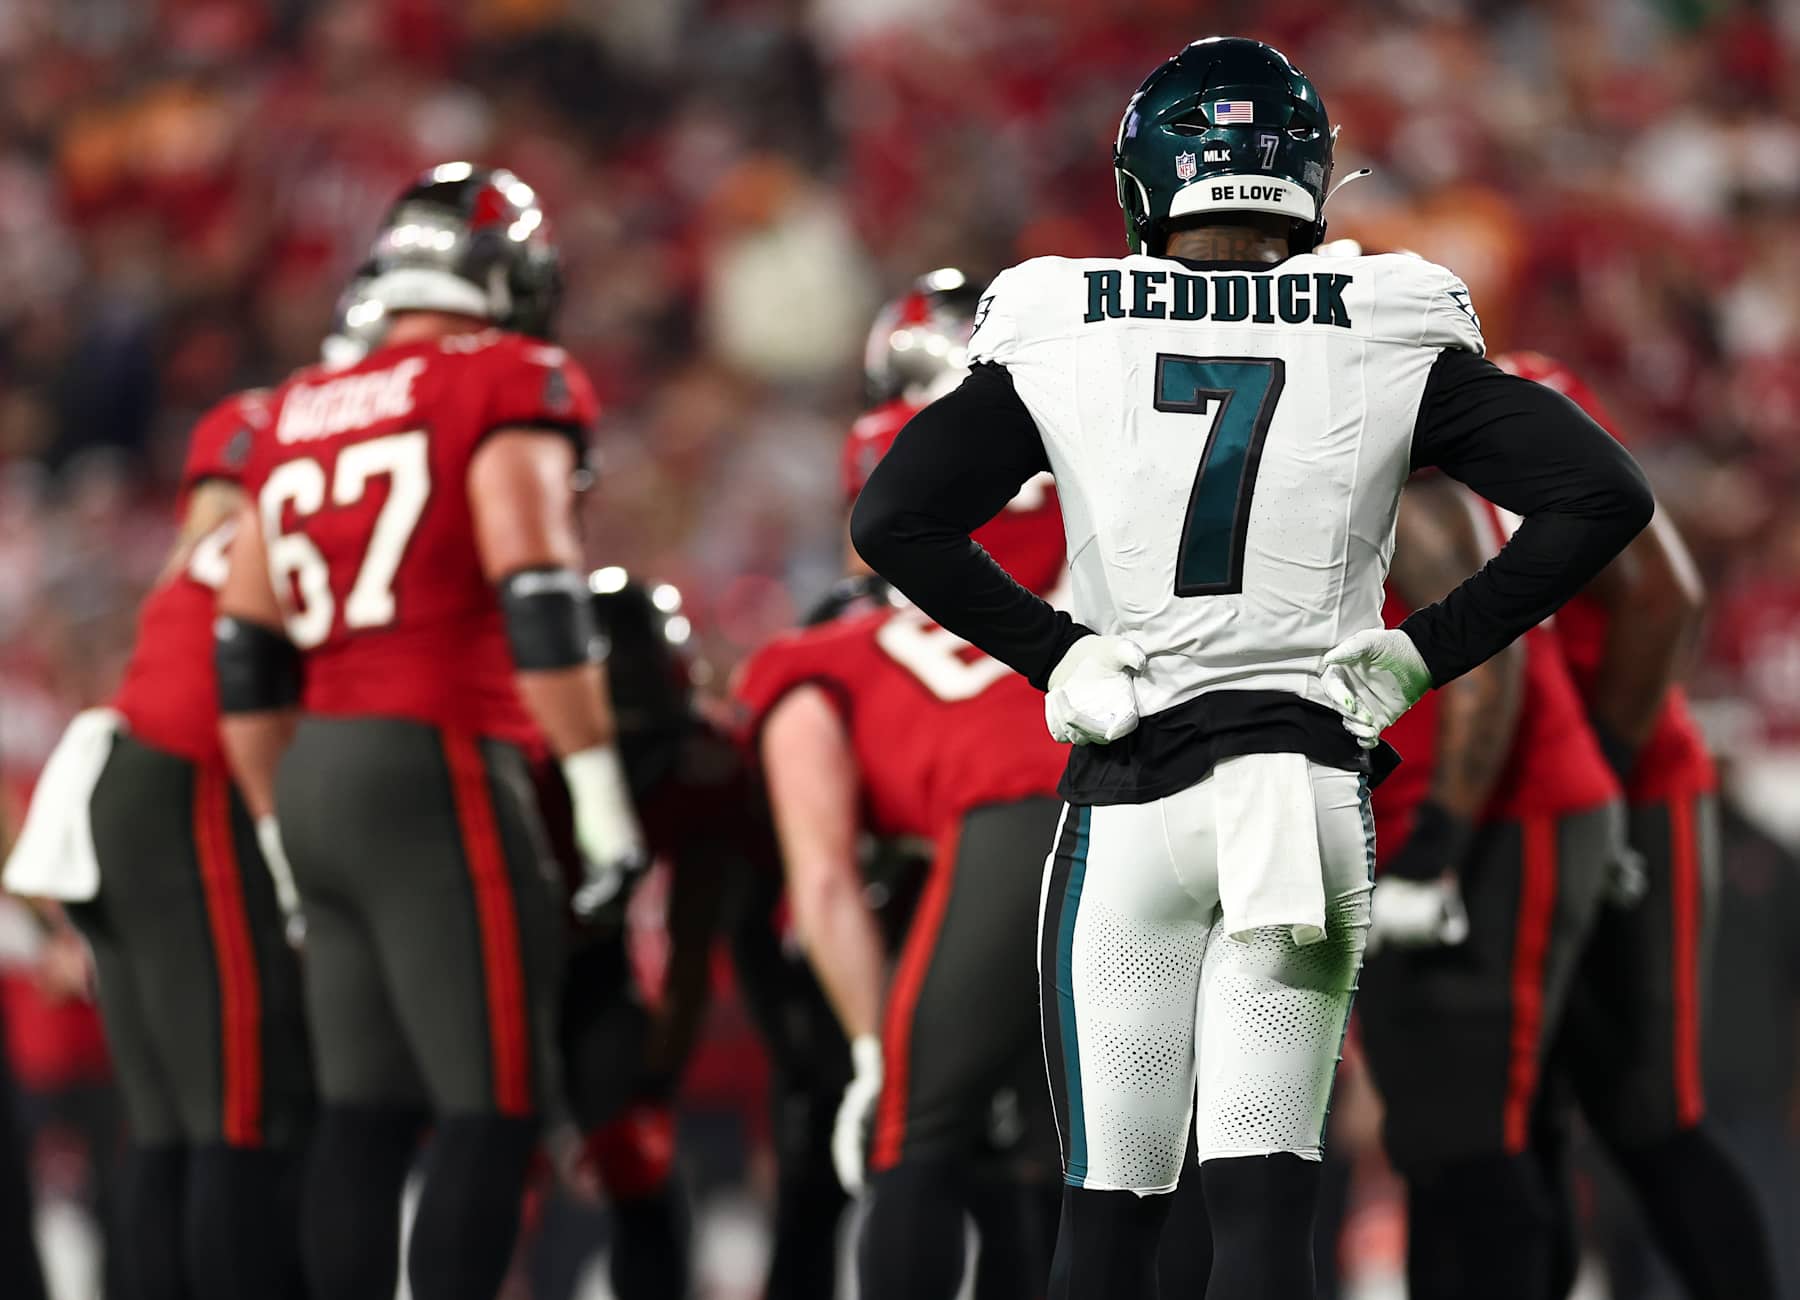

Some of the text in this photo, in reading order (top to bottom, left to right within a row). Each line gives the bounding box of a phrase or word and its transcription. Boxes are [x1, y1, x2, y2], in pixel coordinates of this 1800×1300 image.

[1203, 150, 1231, 162] MLK
[1260, 134, 1279, 170] 7
[1179, 164, 1194, 177] NFL
[1211, 185, 1283, 202] BE LOVE
[1084, 269, 1354, 329] REDDICK
[1153, 352, 1286, 598] 7
[258, 430, 431, 648] 67
